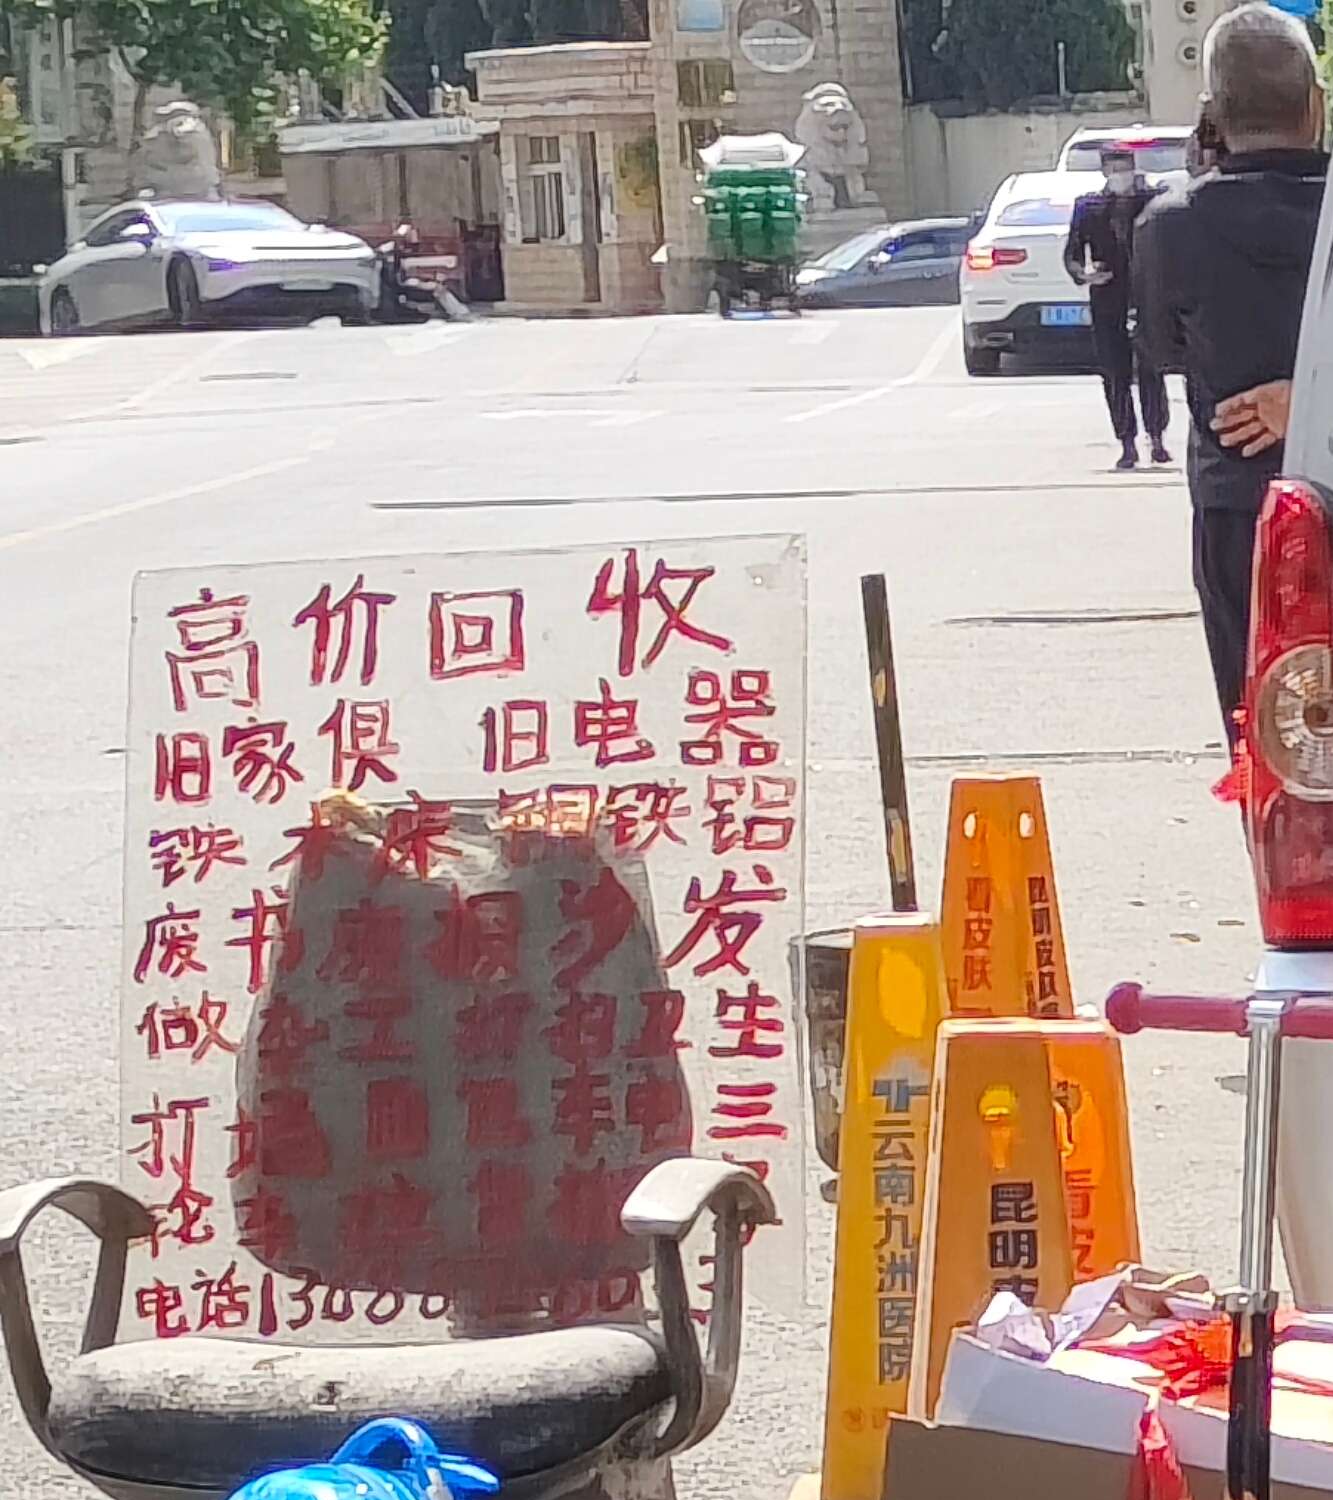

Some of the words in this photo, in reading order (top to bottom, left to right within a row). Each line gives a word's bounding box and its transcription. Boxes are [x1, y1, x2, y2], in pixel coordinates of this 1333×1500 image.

[166, 548, 734, 711] 高价回收
[155, 698, 399, 804] 旧家俱
[481, 668, 779, 773] 旧电器
[871, 1119, 918, 1386] 云南九洲医院
